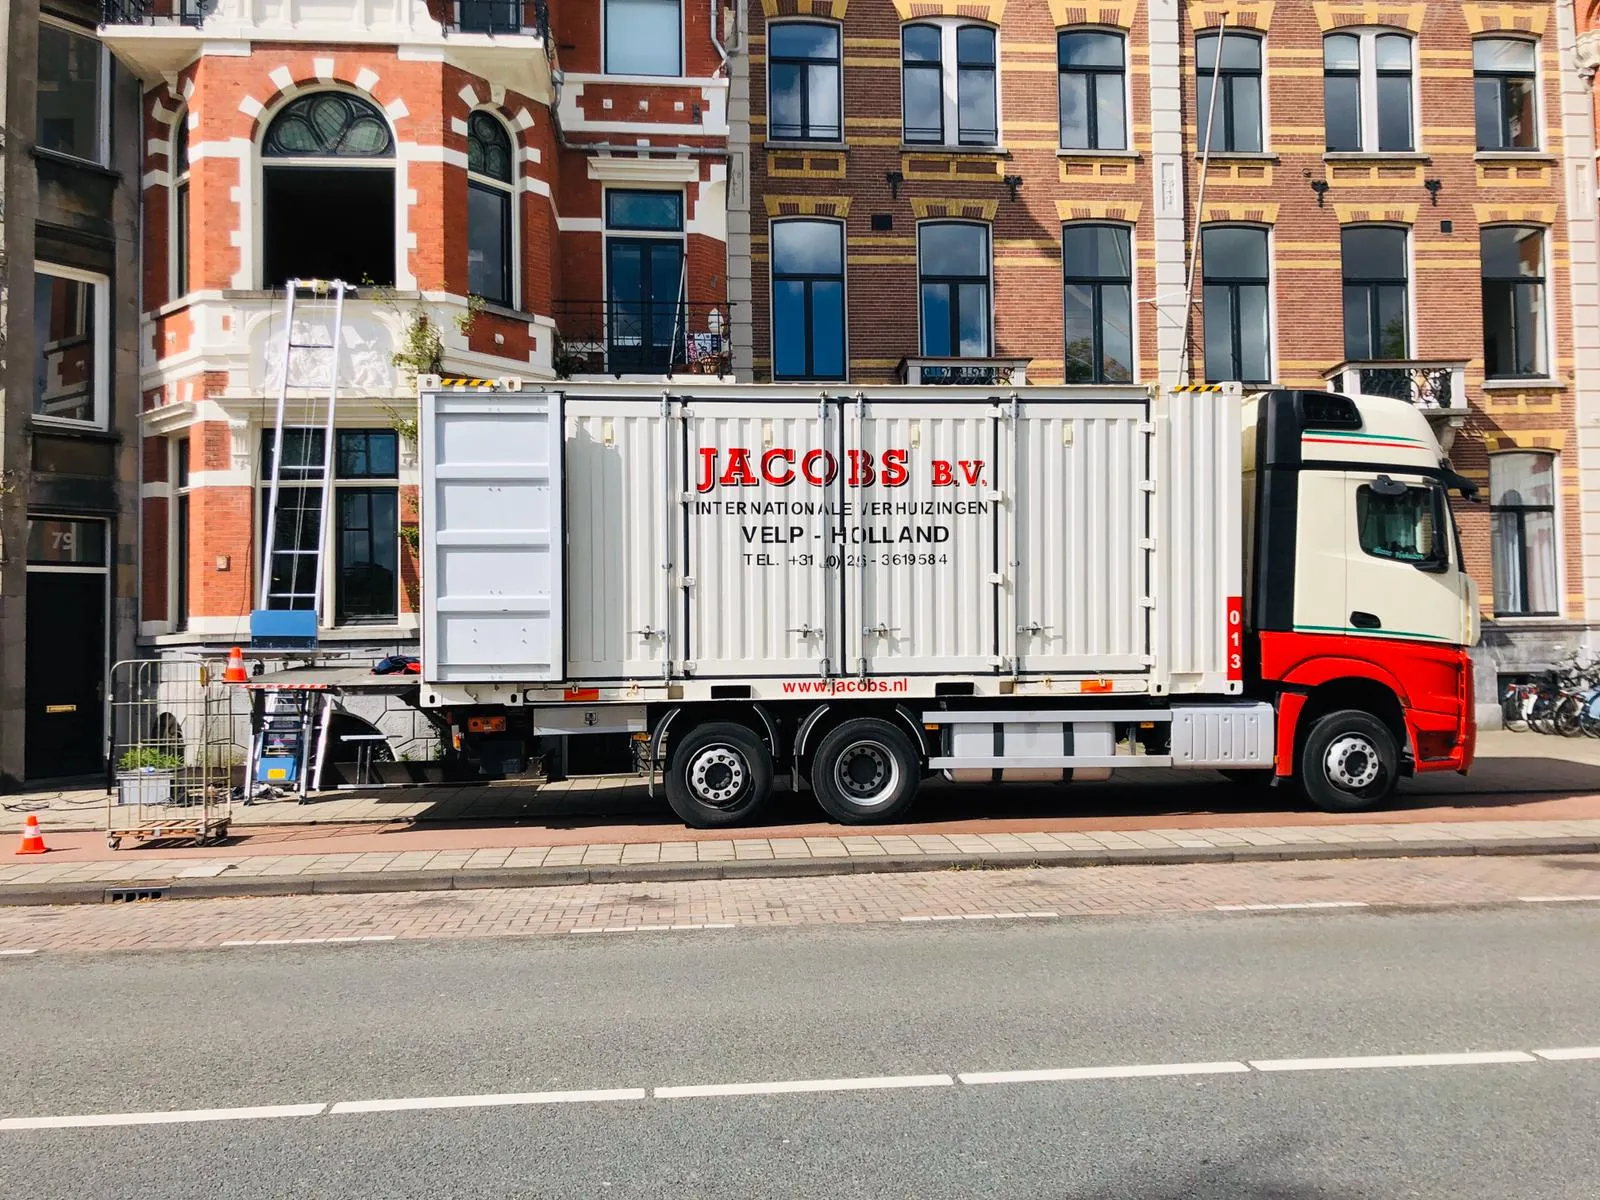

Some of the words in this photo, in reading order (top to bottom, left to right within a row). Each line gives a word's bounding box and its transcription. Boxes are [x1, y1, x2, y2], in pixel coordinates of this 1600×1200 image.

[696, 447, 909, 494] JACOBS
[931, 459, 988, 487] B.V.
[695, 501, 853, 516] INTERNATIONALE
[51, 531, 73, 550] 79
[741, 526, 804, 544] VELP
[831, 525, 950, 544] HOLLAND
[743, 553, 779, 566] TEL.
[787, 553, 813, 566] +31
[881, 553, 948, 566] 3619584
[782, 678, 908, 696] www.jacobs.nl
